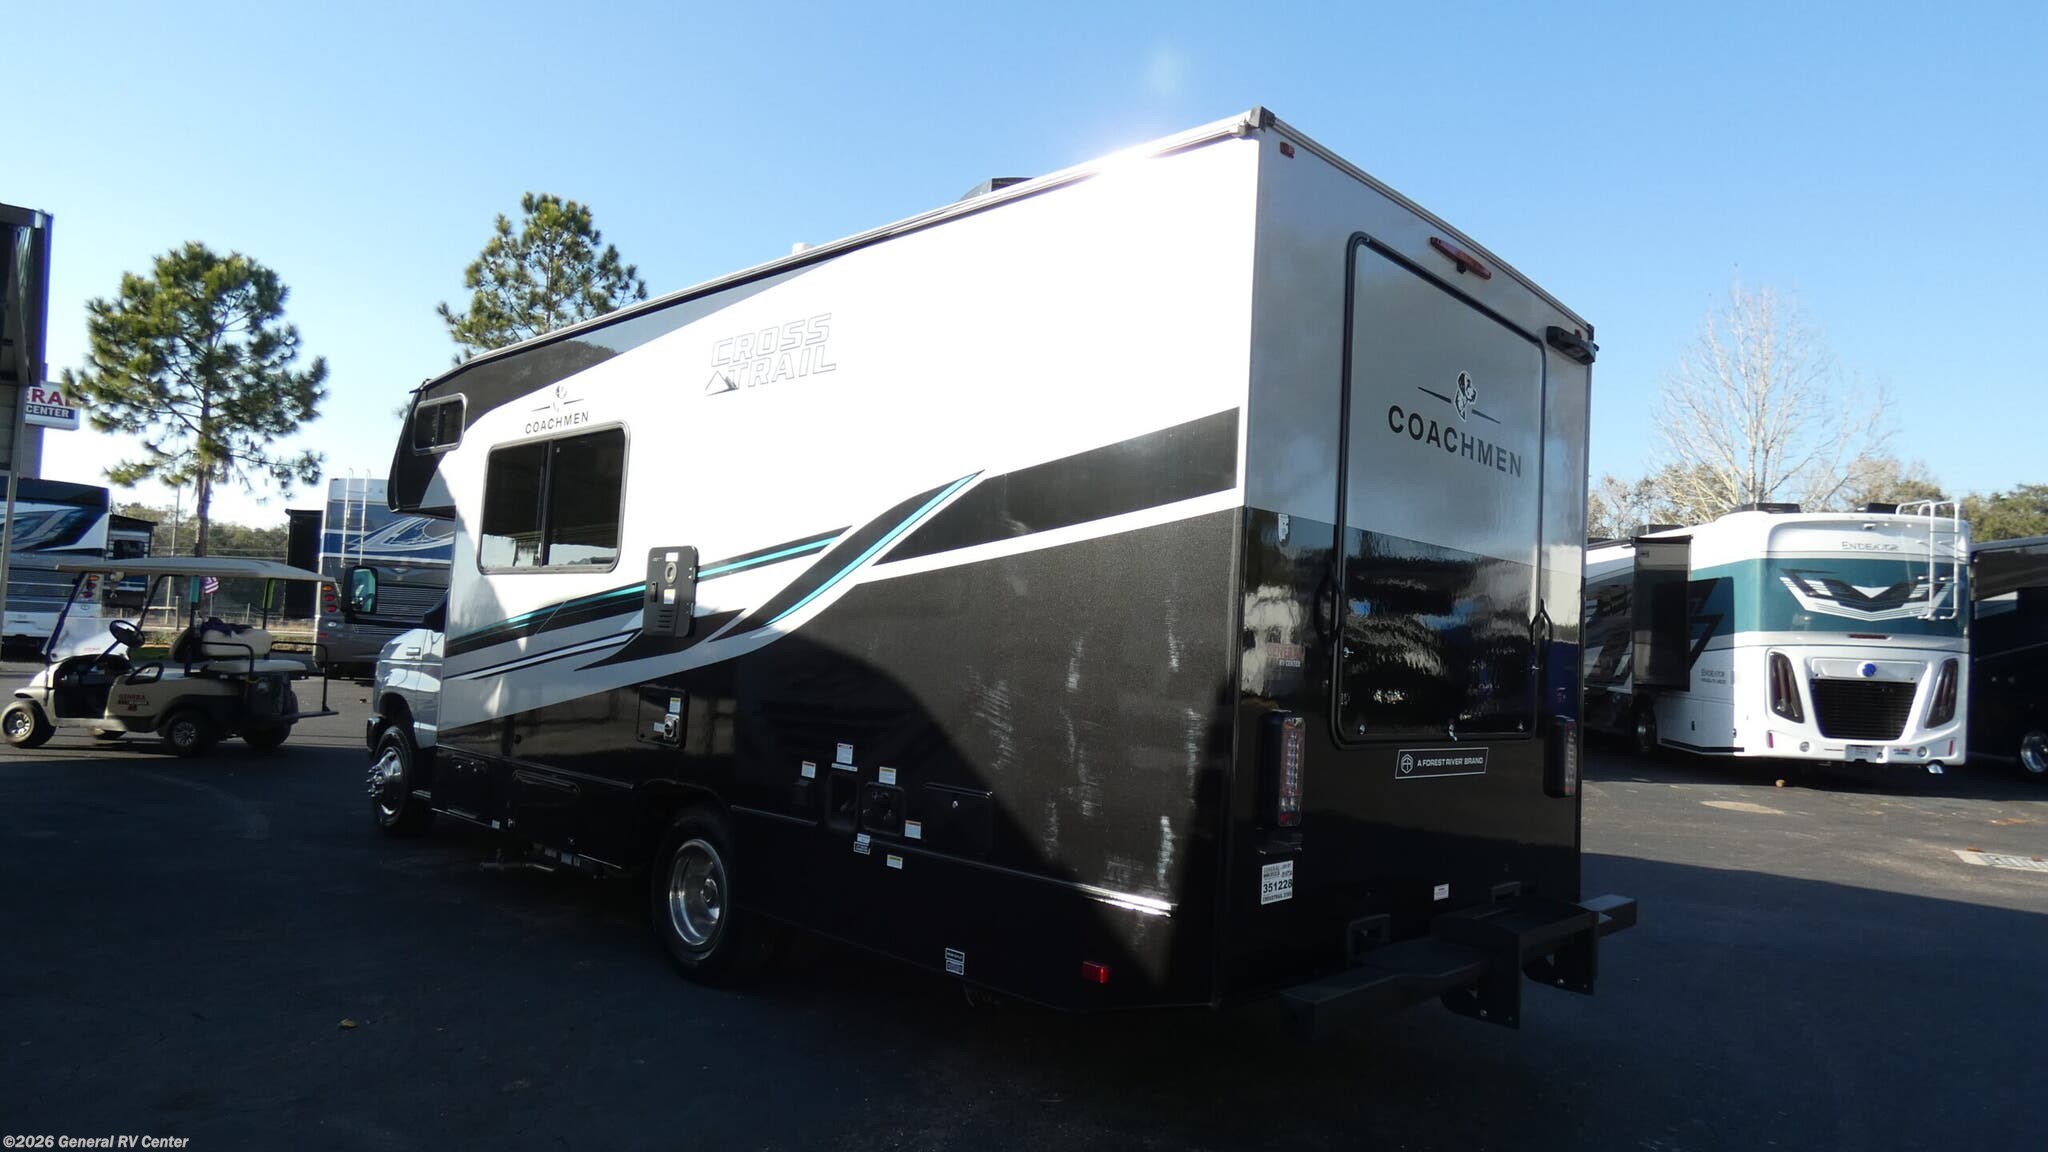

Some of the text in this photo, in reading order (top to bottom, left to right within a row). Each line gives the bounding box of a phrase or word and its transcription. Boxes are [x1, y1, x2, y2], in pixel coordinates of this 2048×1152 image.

[711, 312, 832, 367] CROSS
[728, 344, 837, 389] TRAIL
[25, 405, 69, 418] CENTER
[525, 411, 589, 434] COACHMEN
[1388, 405, 1522, 478] COACHMEN
[1423, 759, 1445, 767] FOREST
[1446, 758, 1463, 766] RIVER
[1464, 757, 1484, 765] BRAND
[1263, 879, 1293, 894] 351228
